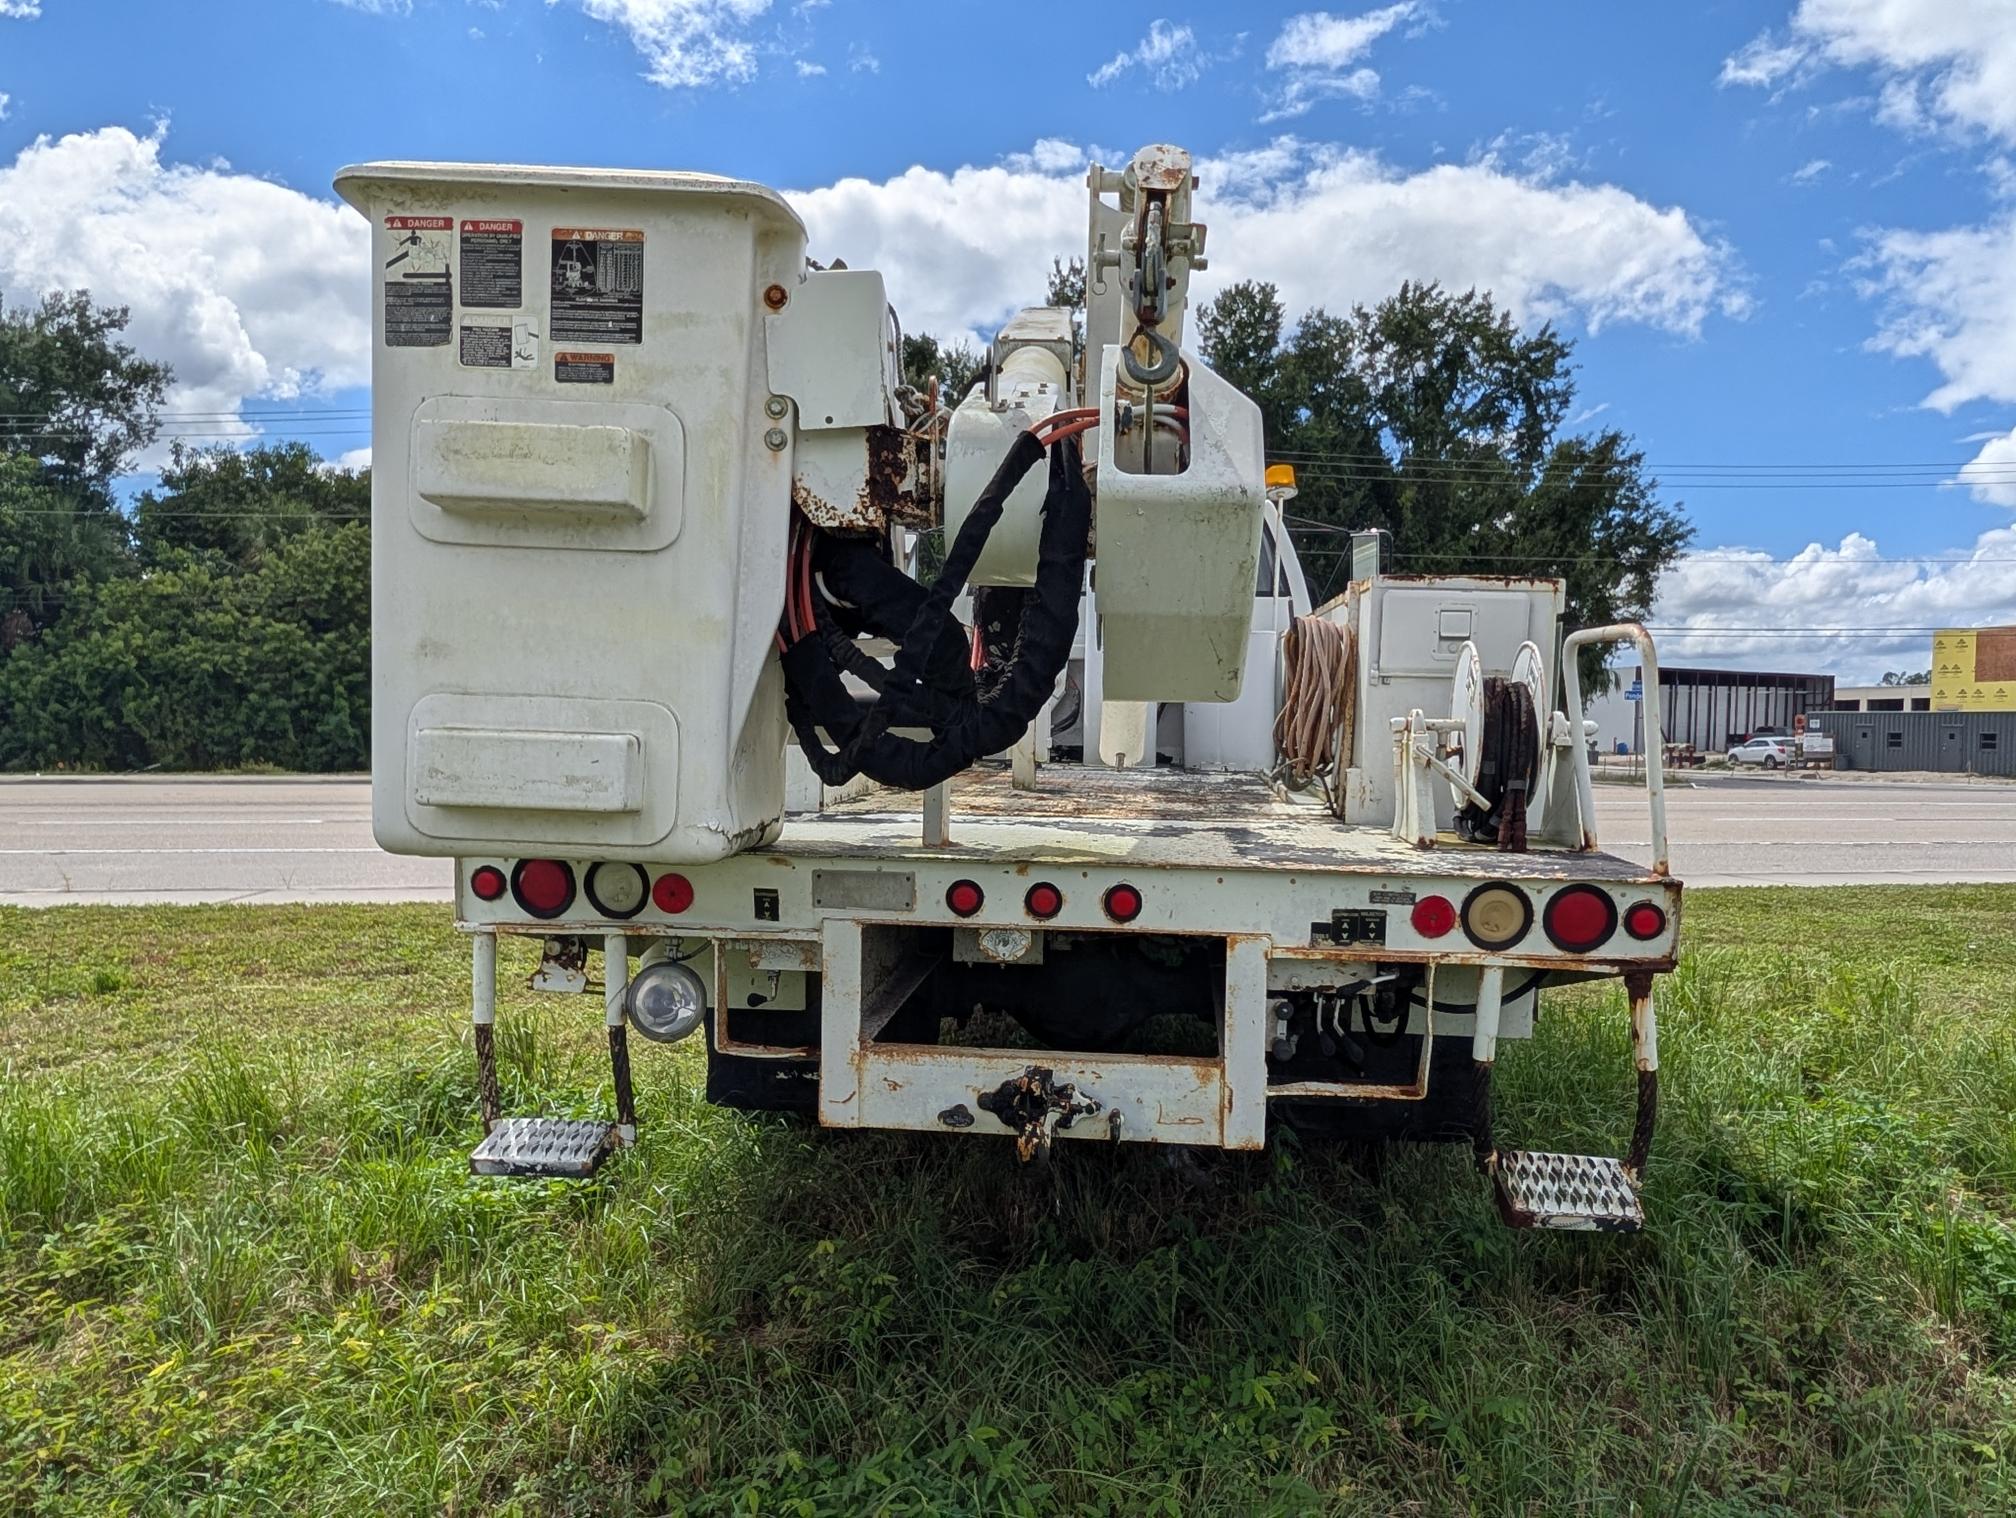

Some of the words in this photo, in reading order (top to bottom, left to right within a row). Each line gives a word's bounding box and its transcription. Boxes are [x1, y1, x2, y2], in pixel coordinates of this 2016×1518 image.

[407, 219, 445, 228] DANGER
[479, 222, 513, 231] DANGER
[585, 231, 624, 241] DANGER
[569, 353, 611, 362] WARNING
